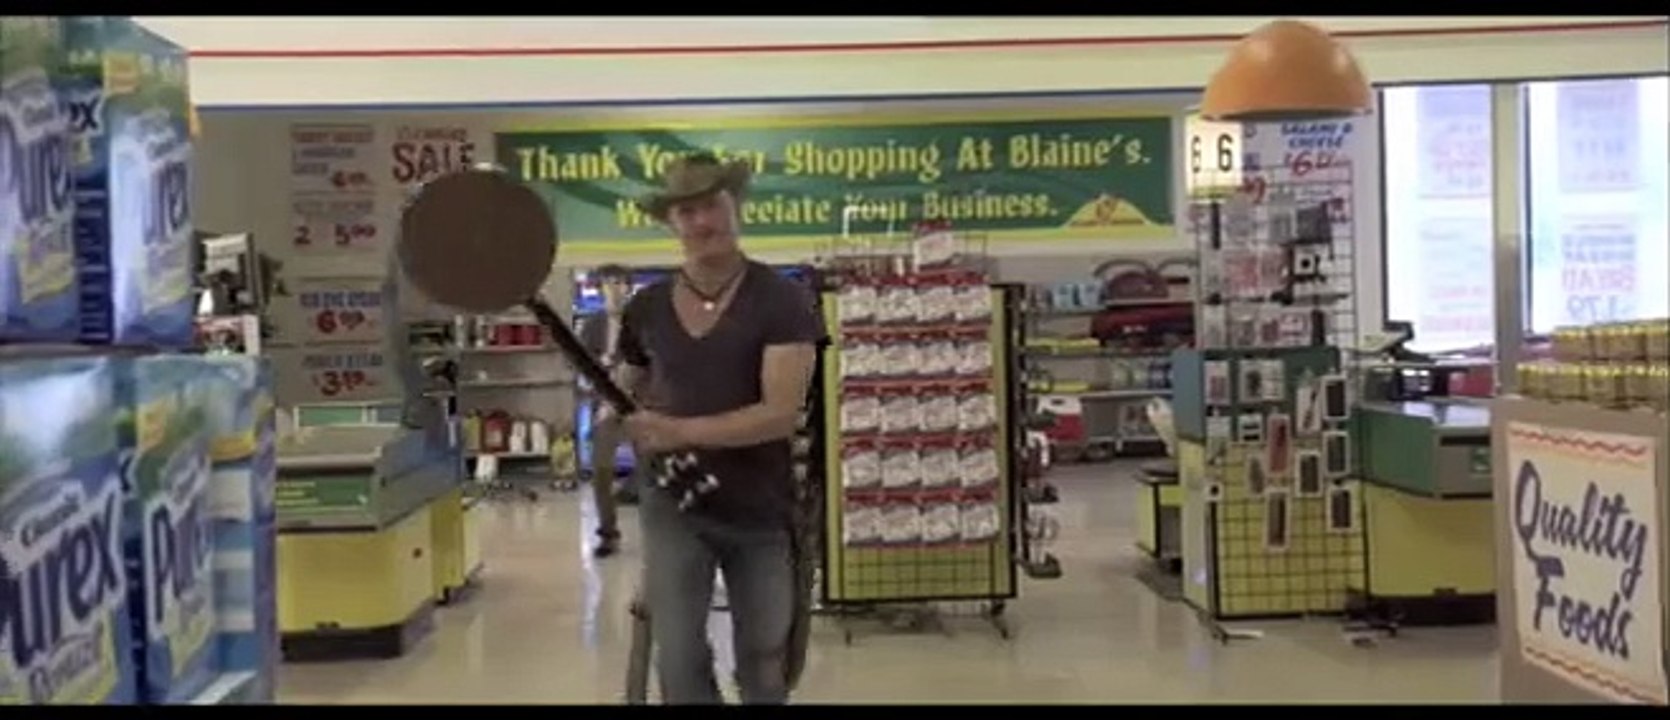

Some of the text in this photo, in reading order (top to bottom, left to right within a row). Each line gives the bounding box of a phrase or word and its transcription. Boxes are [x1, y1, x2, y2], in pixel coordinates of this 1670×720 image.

[392, 142, 475, 183] SALE
[517, 146, 621, 181] Thank
[637, 144, 687, 179] Yo
[784, 140, 942, 182] Shopping
[957, 136, 994, 170] At
[1009, 132, 1151, 169] Blaine's.
[1217, 133, 1234, 173] 6
[846, 193, 907, 224] Your
[922, 190, 1059, 221] Business.
[293, 225, 312, 246] 2
[1515, 459, 1648, 600] Quality
[1534, 556, 1633, 659] Foods
